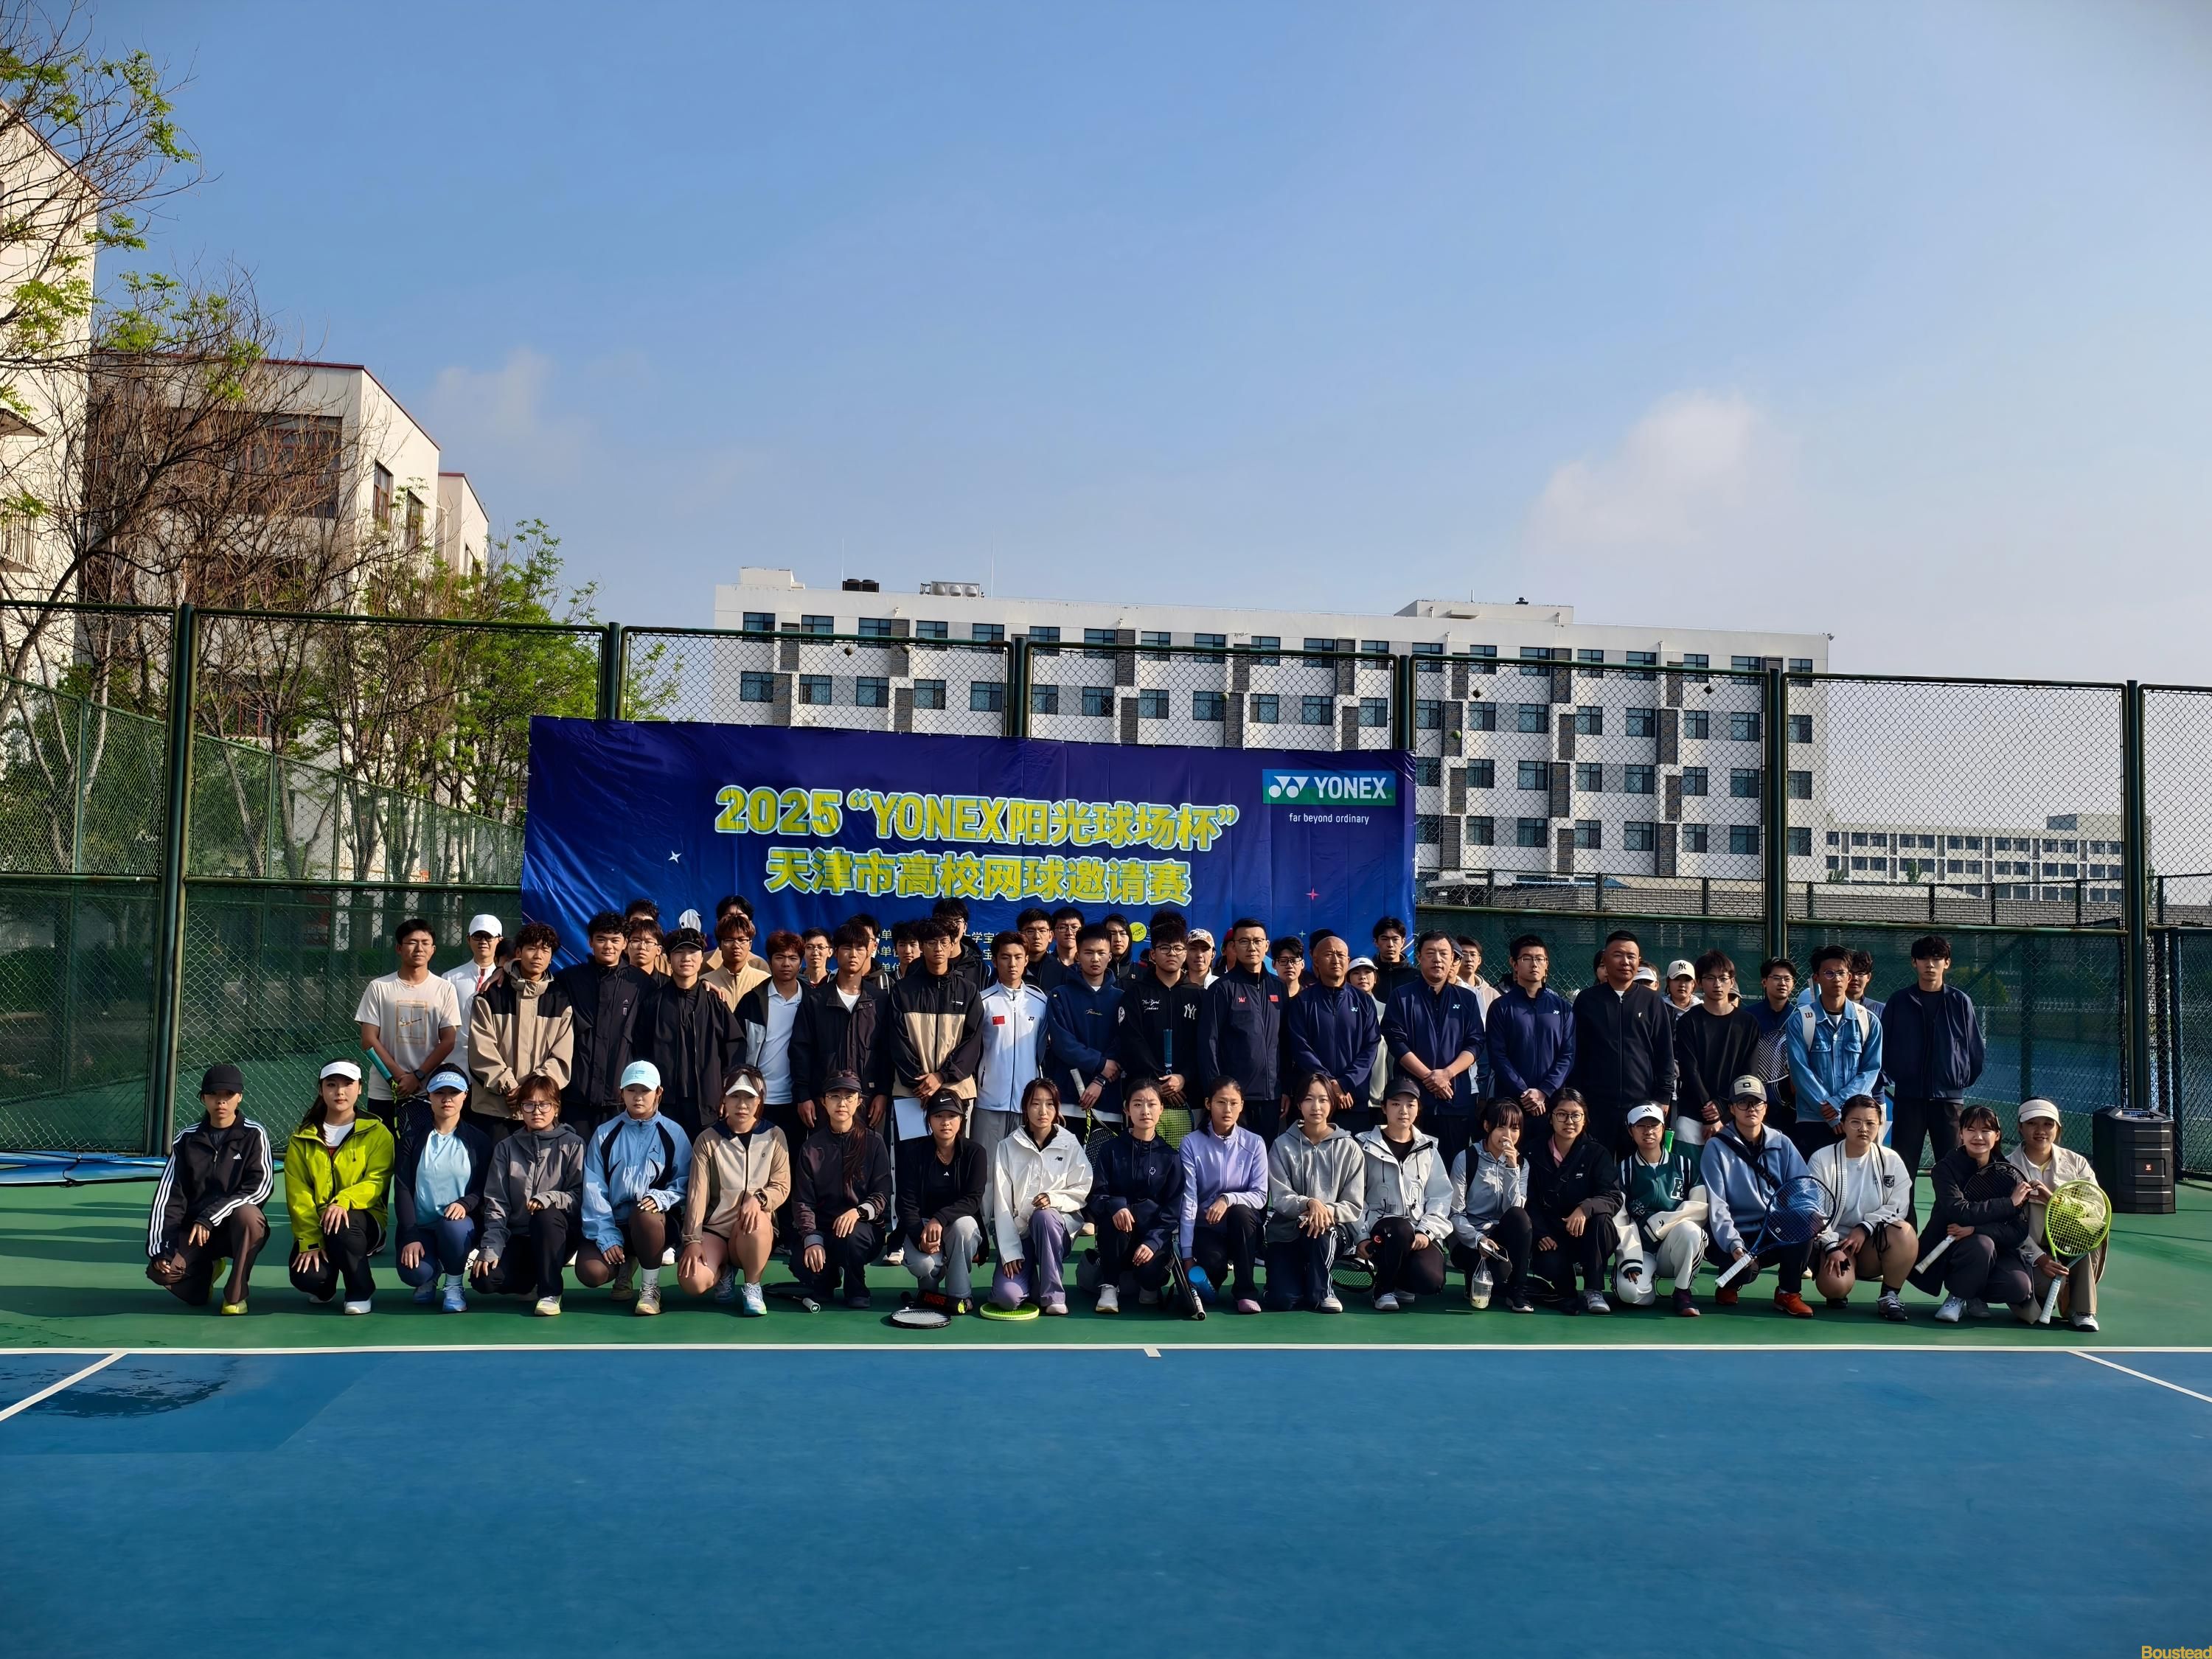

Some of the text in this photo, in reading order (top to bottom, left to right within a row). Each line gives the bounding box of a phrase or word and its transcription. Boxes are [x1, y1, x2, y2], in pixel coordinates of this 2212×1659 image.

[1313, 776, 1387, 799] YONEX
[715, 785, 843, 837] 2025
[1289, 813, 1369, 825] far beyond ordinary
[764, 846, 1191, 906] 天津市高校网球邀请赛
[1183, 1003, 1197, 1020] NY
